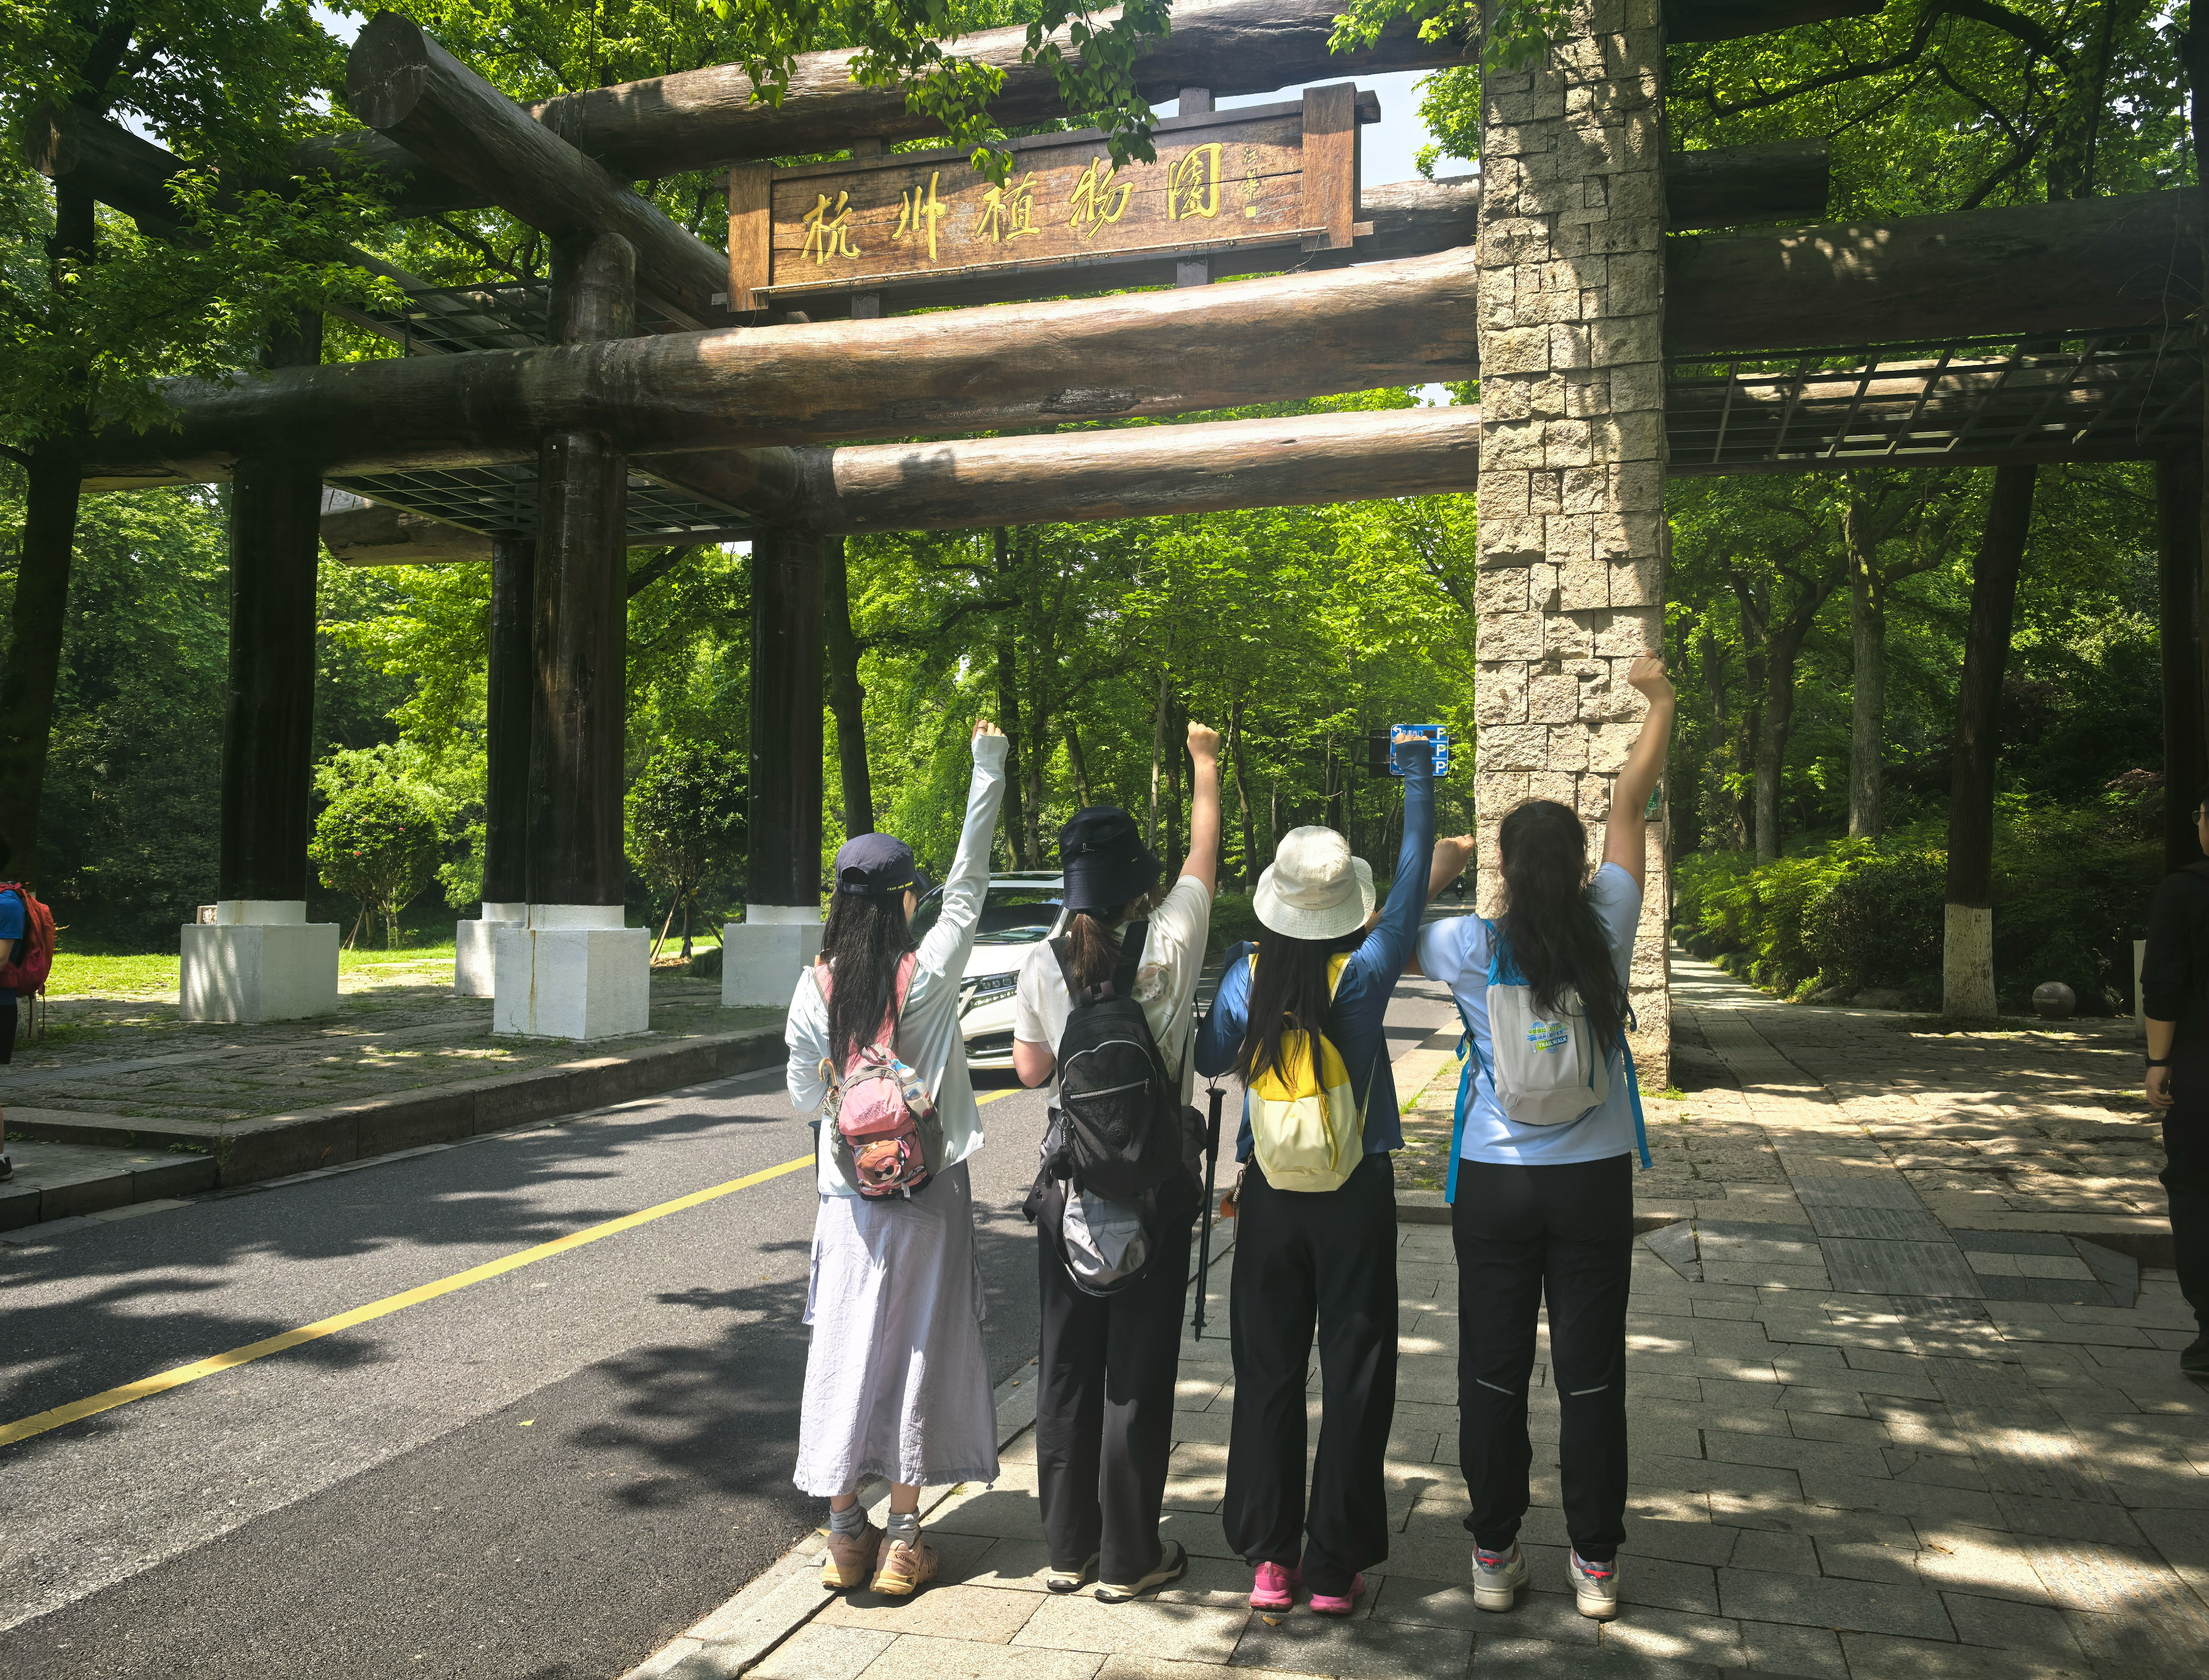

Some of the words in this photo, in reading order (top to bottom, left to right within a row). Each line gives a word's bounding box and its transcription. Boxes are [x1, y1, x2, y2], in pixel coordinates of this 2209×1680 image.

[1437, 727, 1446, 740] P
[1436, 744, 1446, 756] P
[1436, 761, 1446, 773] P
[1538, 1037, 1567, 1048] TRAILWALK
